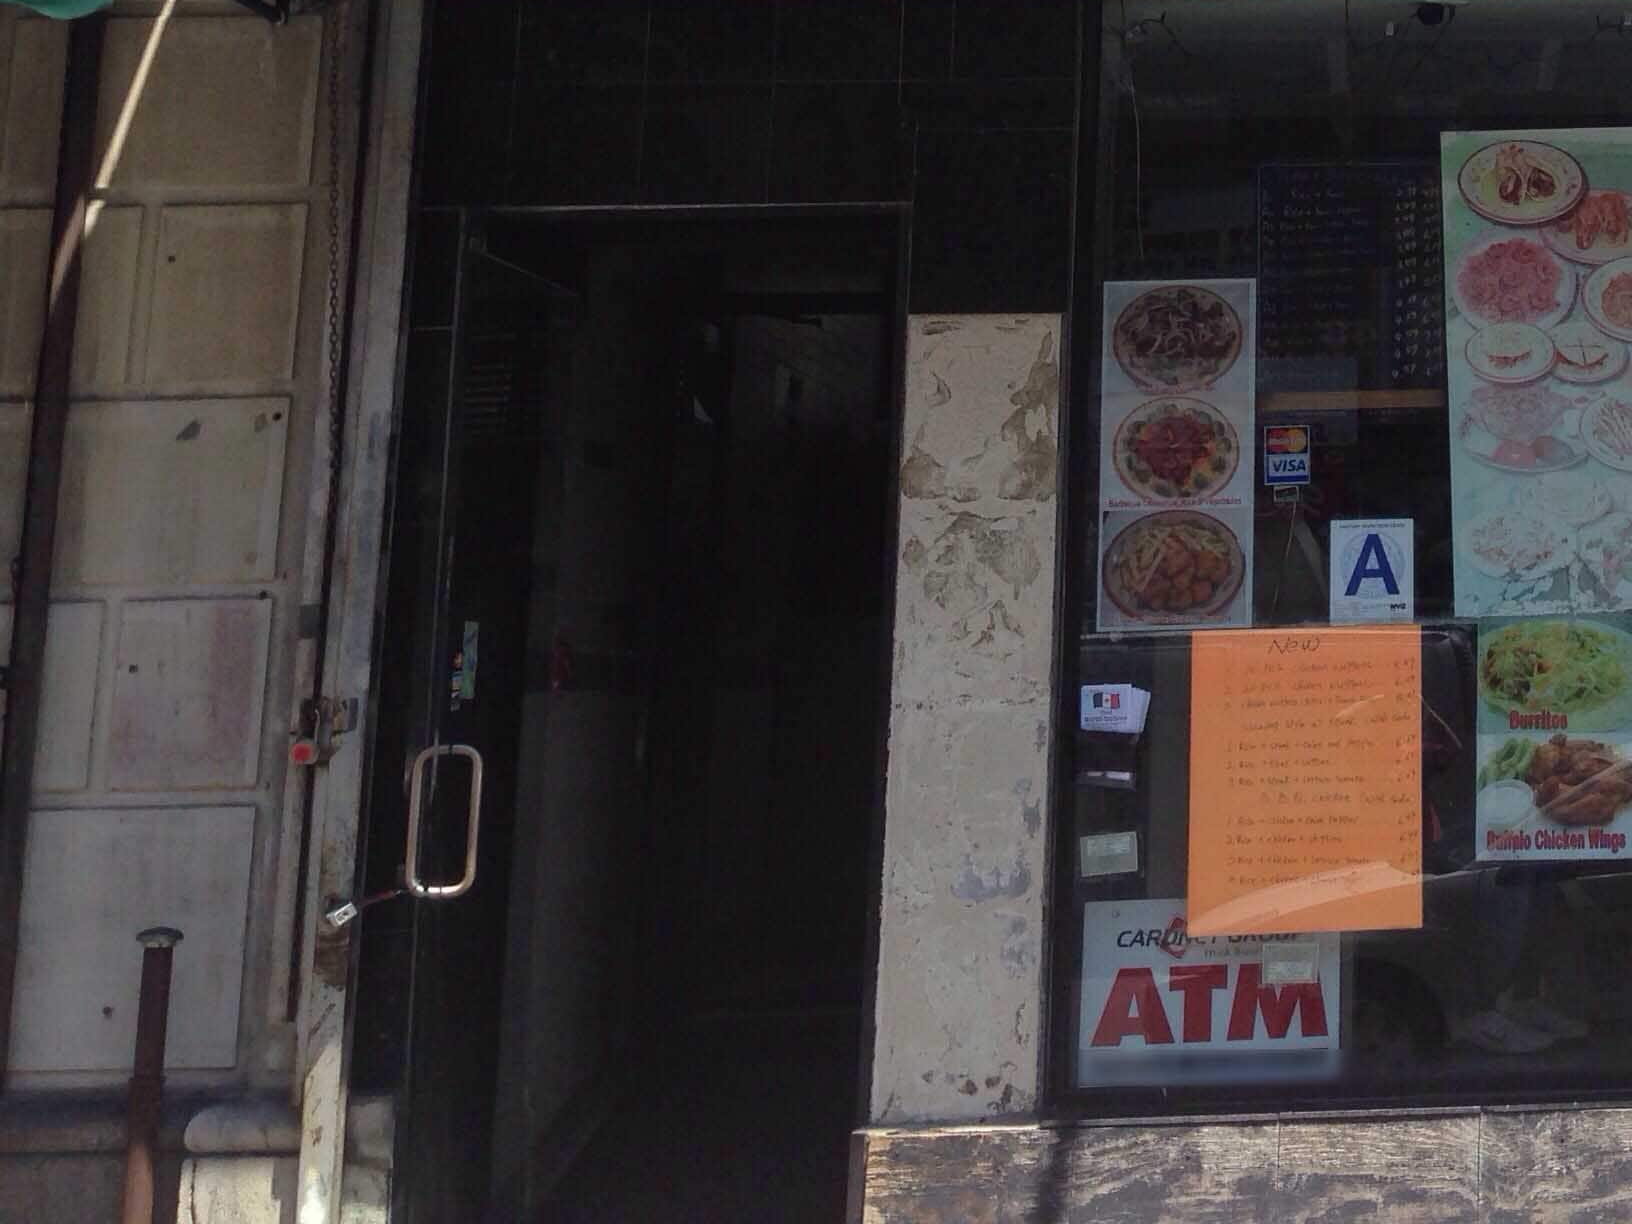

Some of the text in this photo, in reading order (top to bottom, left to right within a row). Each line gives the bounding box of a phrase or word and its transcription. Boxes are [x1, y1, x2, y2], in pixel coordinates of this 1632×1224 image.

[1272, 459, 1307, 473] VISA
[1344, 533, 1400, 596] A
[1534, 828, 1585, 850] Chicken
[1588, 828, 1627, 854] Wings
[1090, 963, 1329, 1048] ATM
